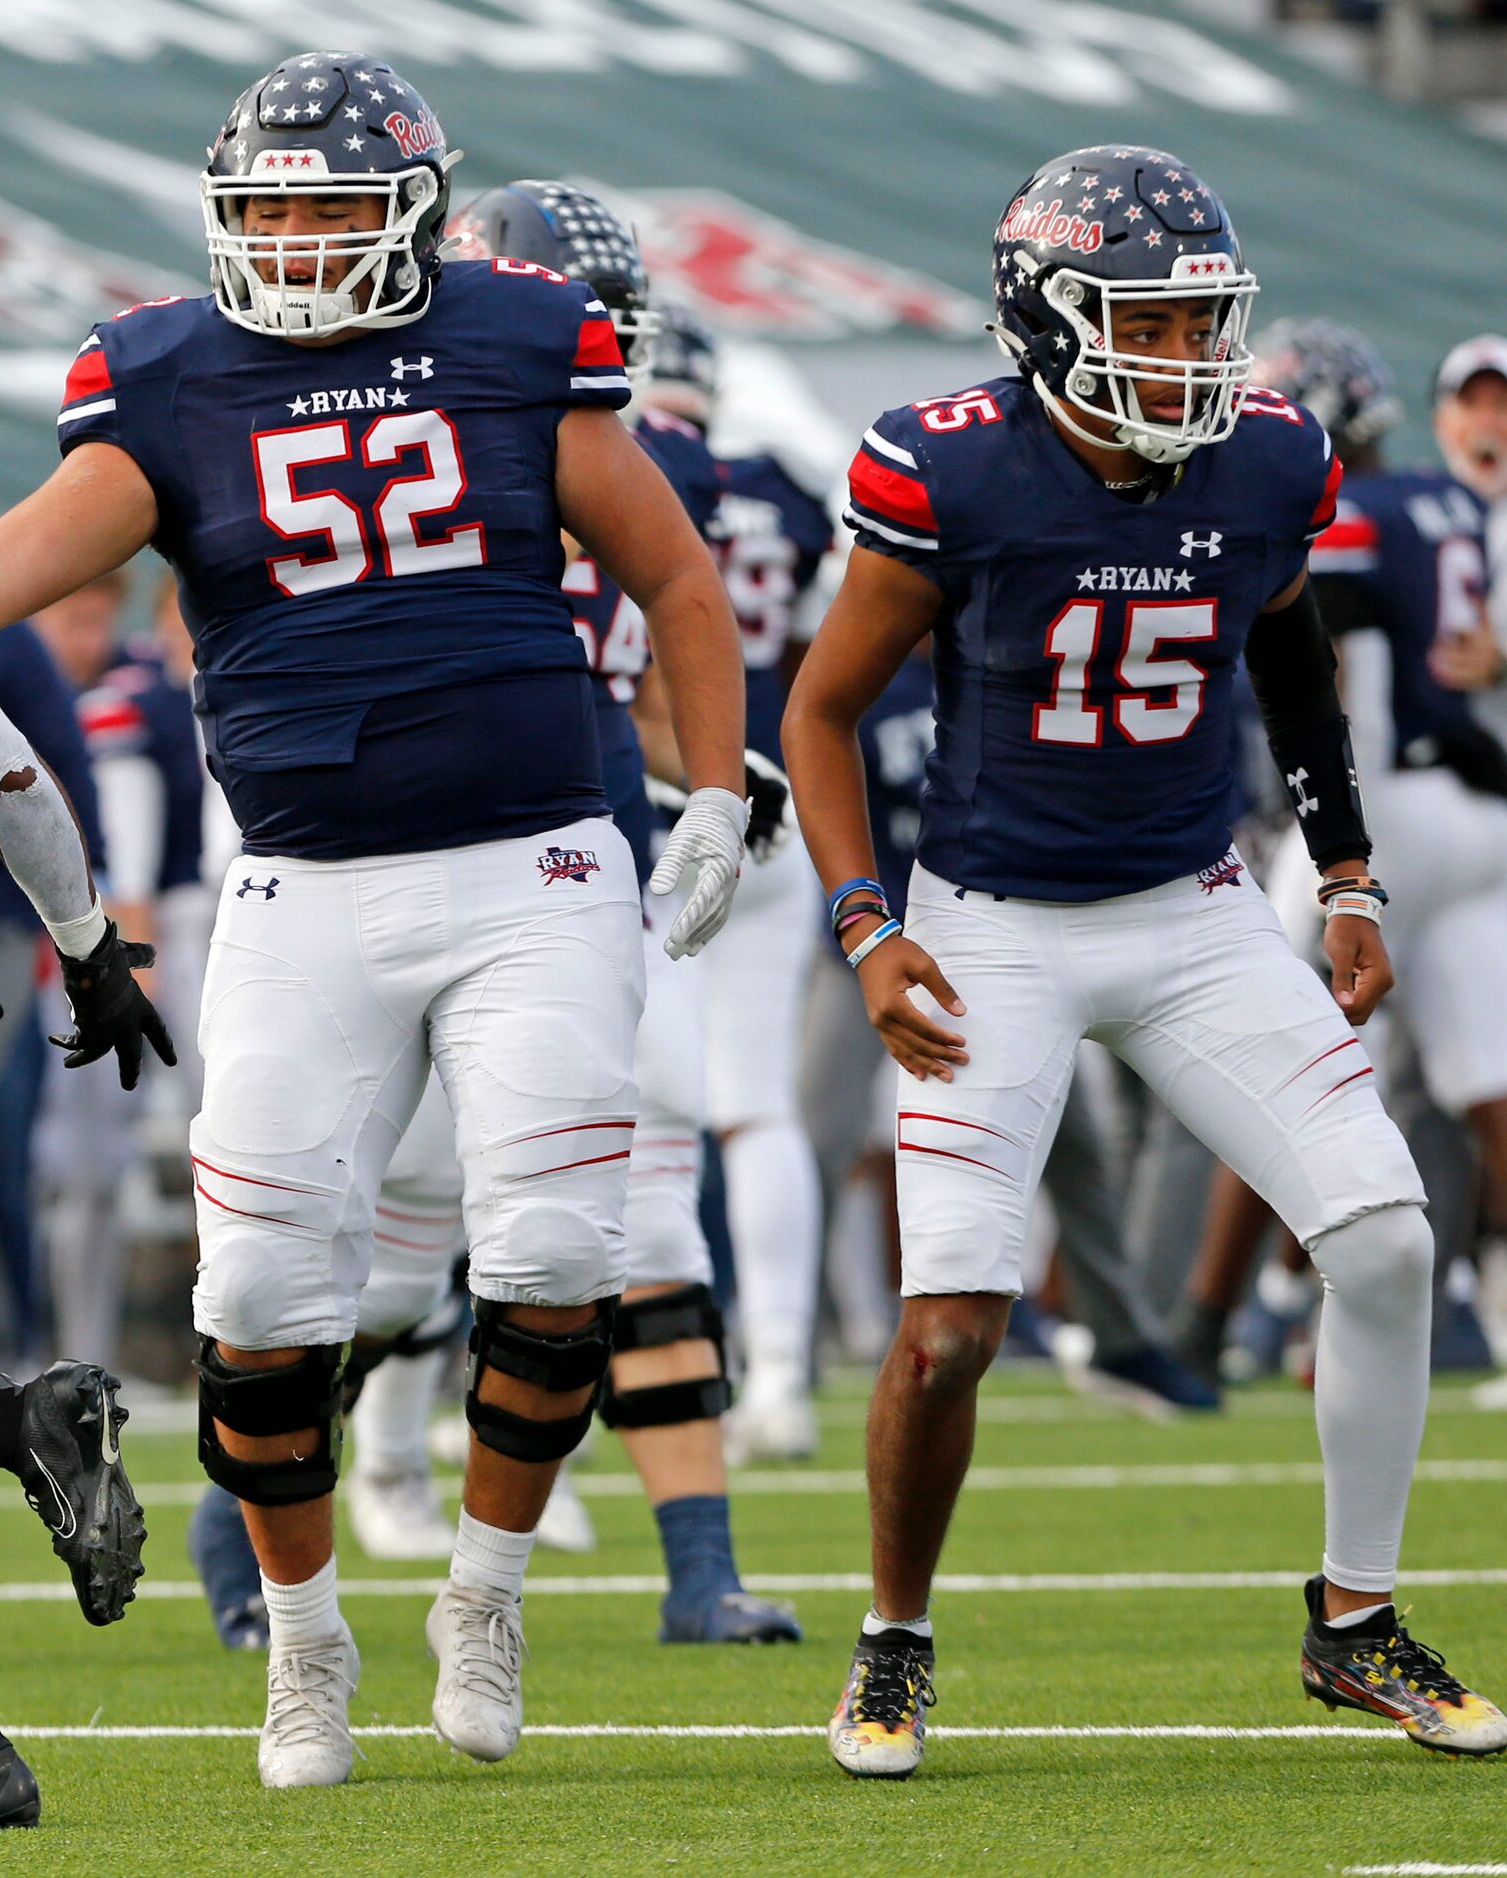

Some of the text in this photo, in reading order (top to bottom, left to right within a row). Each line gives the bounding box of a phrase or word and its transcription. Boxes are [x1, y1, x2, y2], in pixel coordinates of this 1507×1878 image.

[998, 195, 1104, 255] Raiders
[310, 387, 387, 414] RYAN
[251, 408, 488, 598] 52
[1098, 566, 1175, 591] RYAN
[1031, 597, 1219, 748] 15
[540, 851, 597, 872] RYAN
[1198, 852, 1241, 882] RYAN
